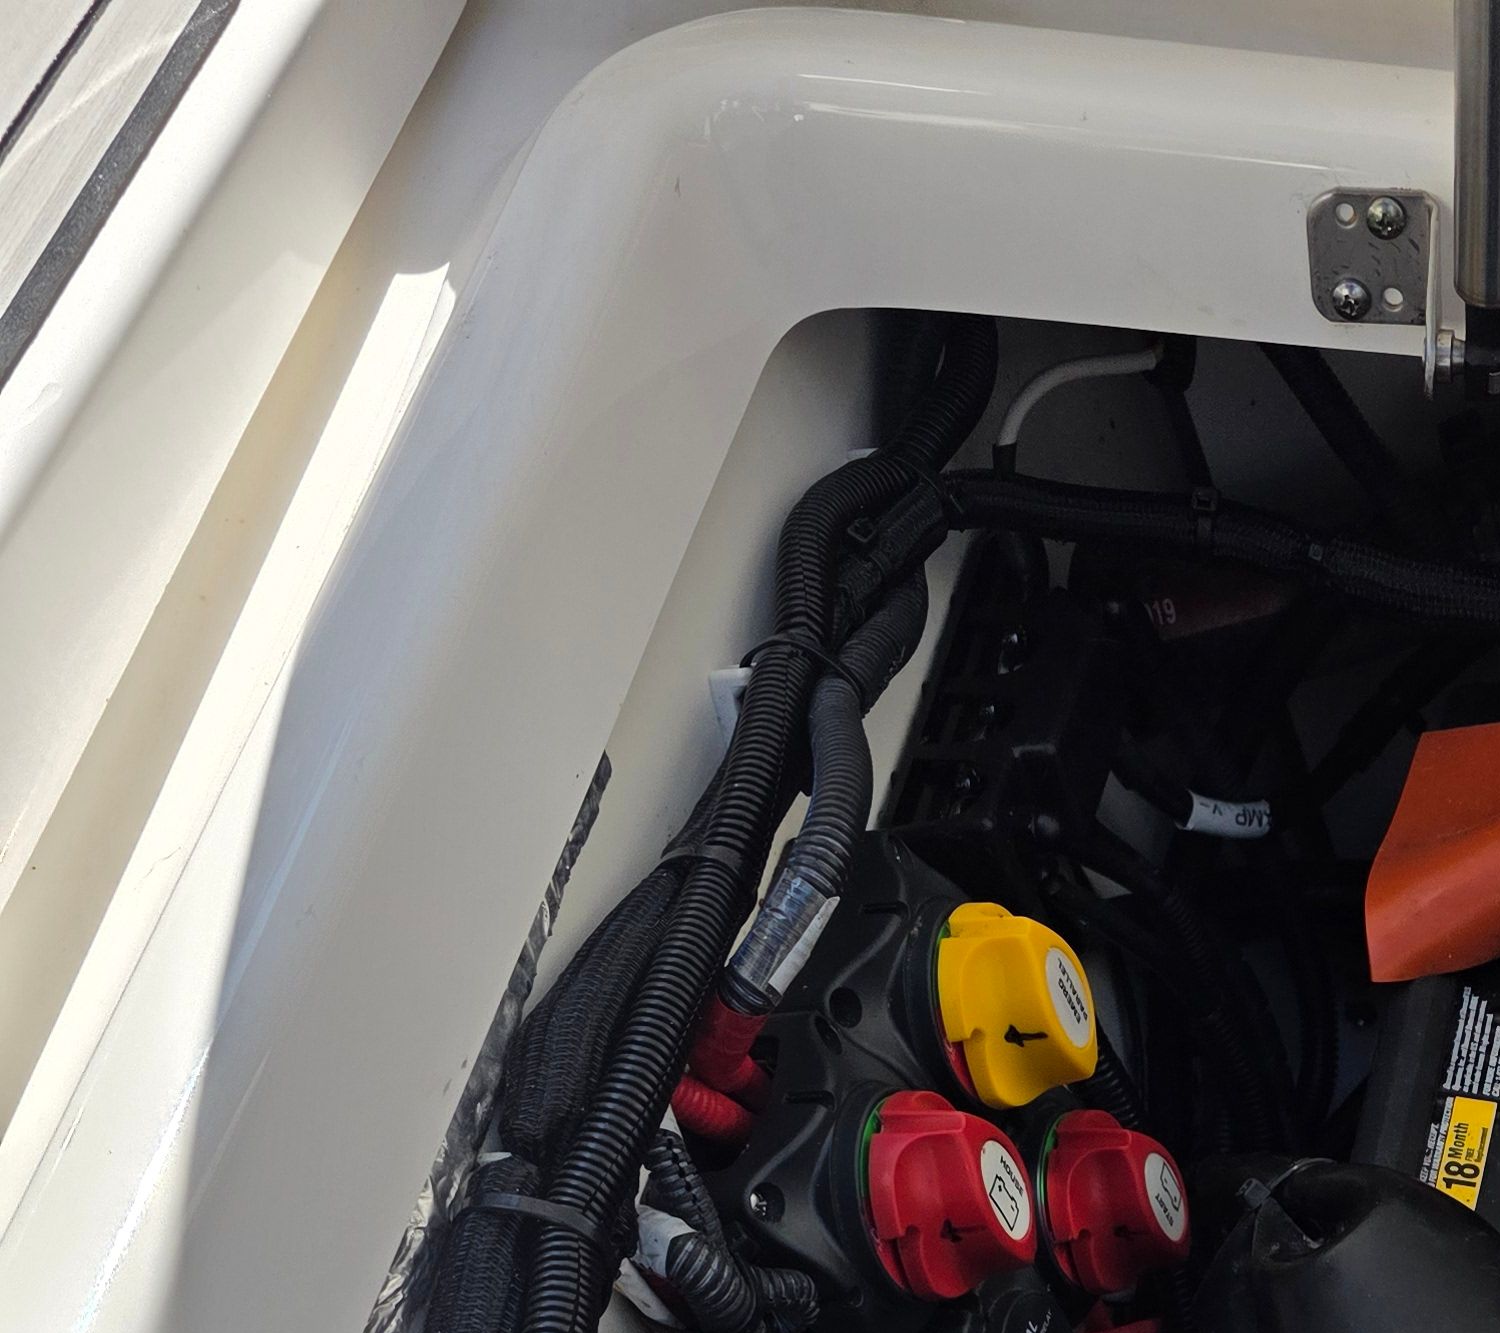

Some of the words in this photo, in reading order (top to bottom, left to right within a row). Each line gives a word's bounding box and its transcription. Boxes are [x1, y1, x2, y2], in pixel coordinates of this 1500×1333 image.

[1056, 955, 1089, 1023] PARALLEL
[1056, 976, 1082, 1026] EMERG
[1447, 1120, 1470, 1159] Month
[998, 1152, 1025, 1199] HOUSE
[1440, 1158, 1480, 1193] 18
[1154, 1191, 1174, 1228] START
